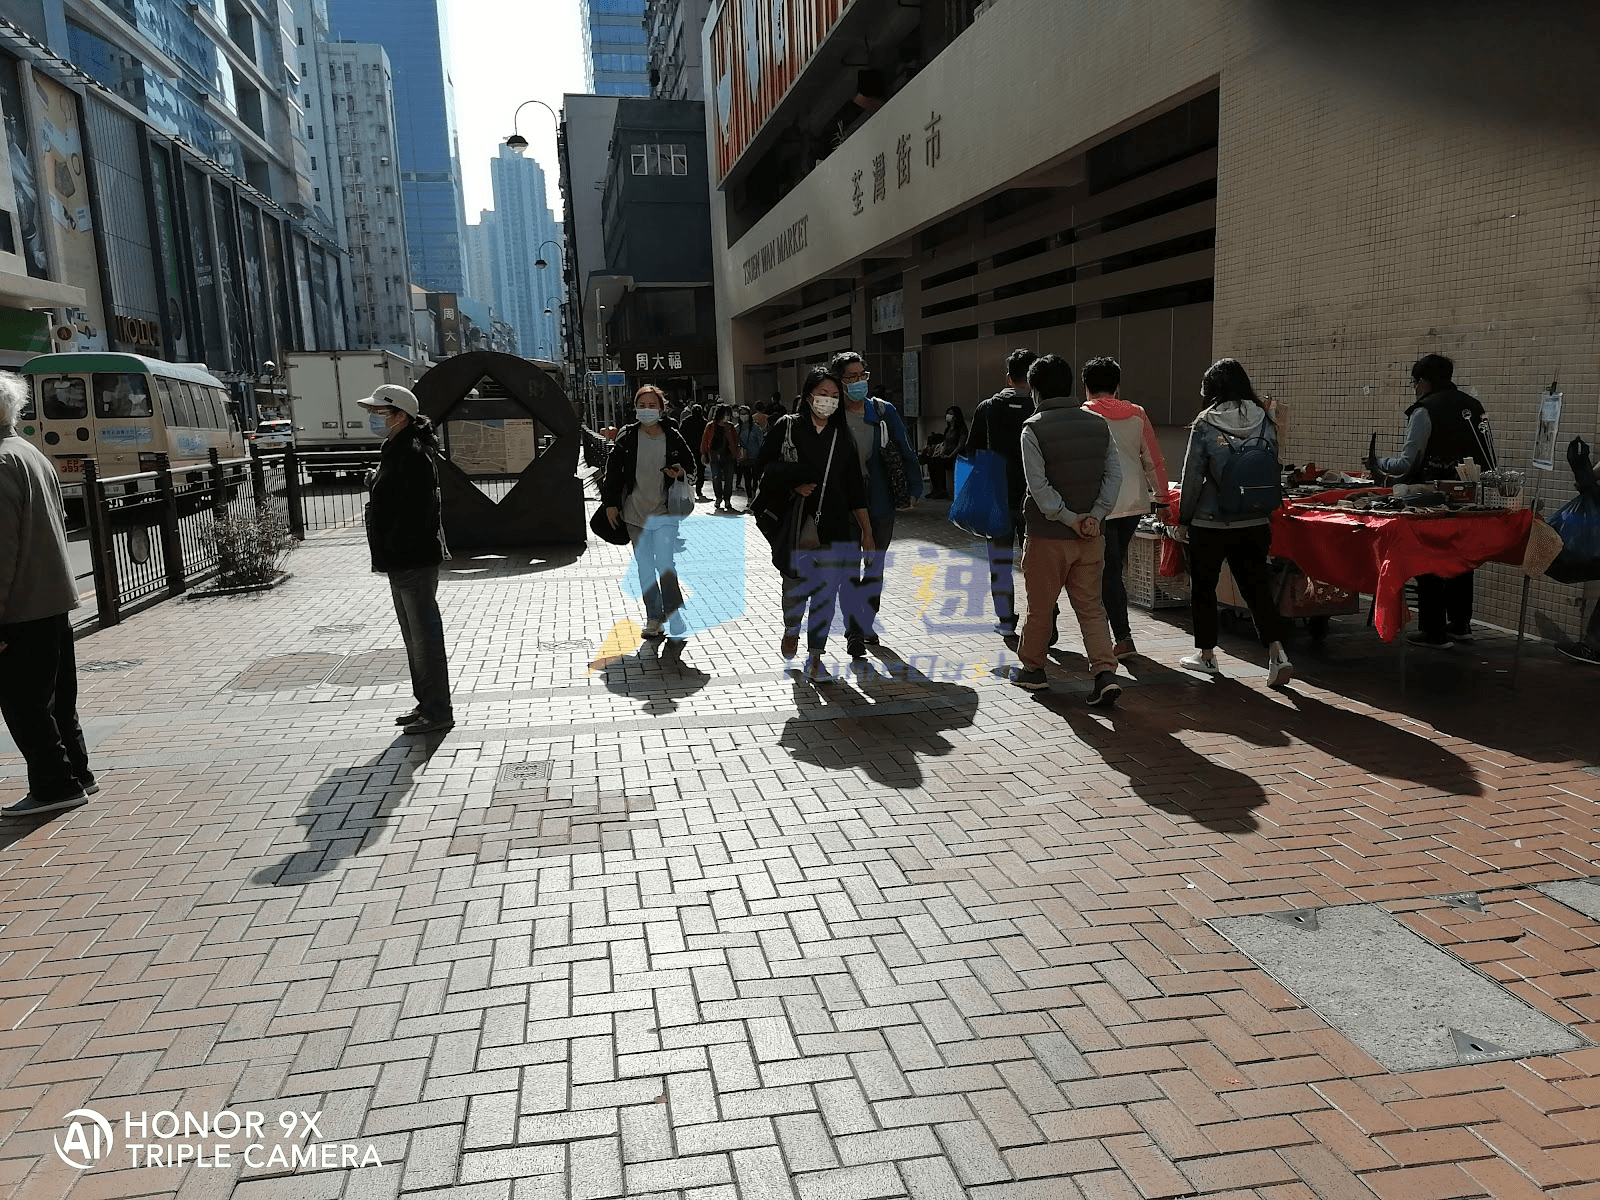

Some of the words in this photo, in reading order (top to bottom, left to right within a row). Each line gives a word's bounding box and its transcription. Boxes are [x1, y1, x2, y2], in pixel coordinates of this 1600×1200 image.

[851, 111, 942, 216] 荃灣街市
[743, 254, 761, 286] TSUEN
[761, 239, 776, 274] WAN
[777, 213, 809, 265] MARKET
[635, 351, 683, 371] 周大福
